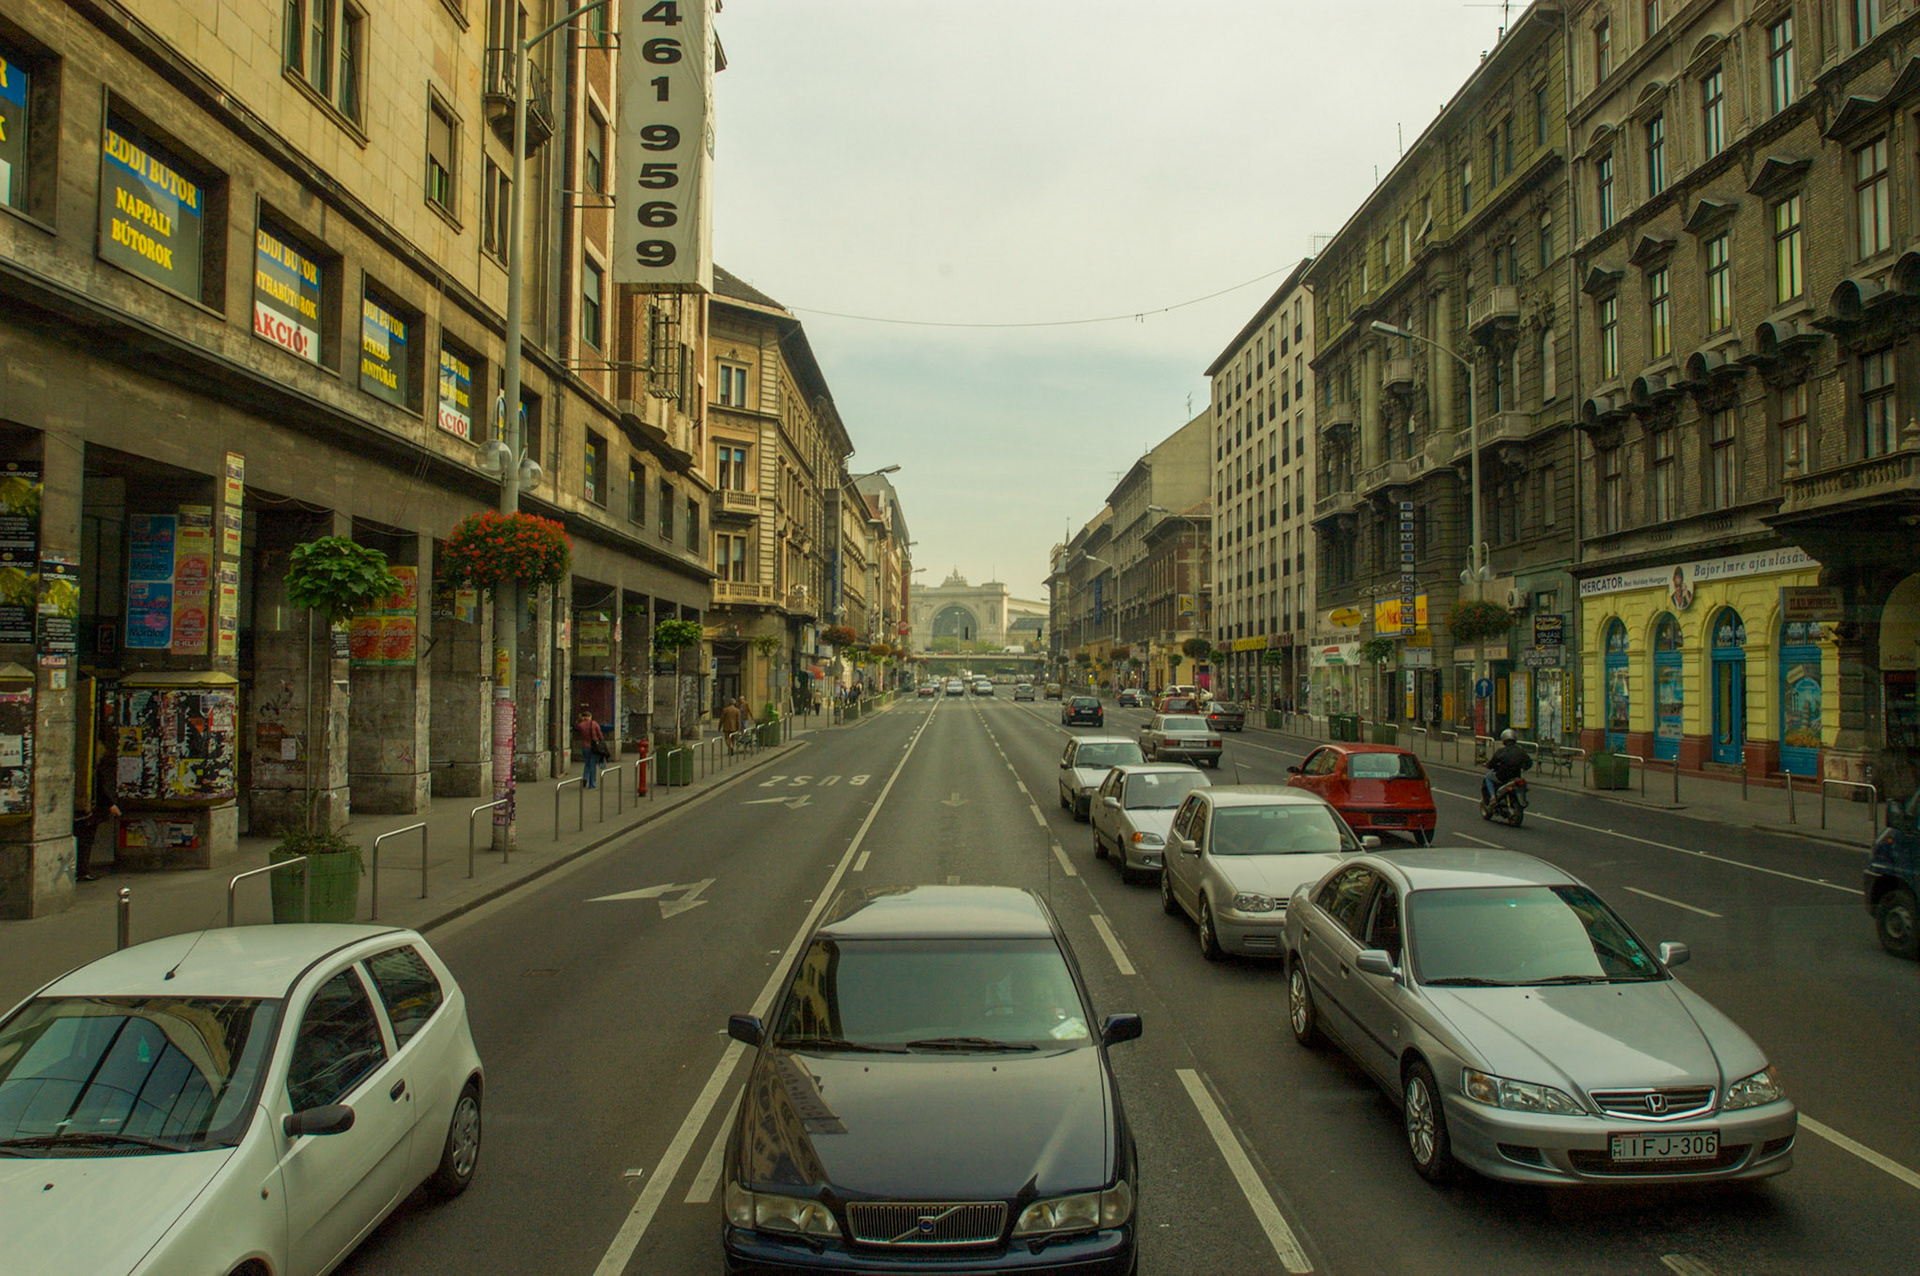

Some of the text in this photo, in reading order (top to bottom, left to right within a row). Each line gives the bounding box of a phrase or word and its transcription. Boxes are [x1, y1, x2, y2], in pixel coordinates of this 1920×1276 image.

[636, 124, 681, 268] 9569
[116, 187, 171, 237] NAPPALI
[111, 217, 173, 270] BÚTOROK
[1694, 563, 1720, 579] Bajor
[1722, 561, 1746, 573] Imre
[1580, 576, 1623, 594] MERCATOR
[758, 774, 871, 788] BUSZ
[1613, 1136, 1716, 1157] H IFJ-306
